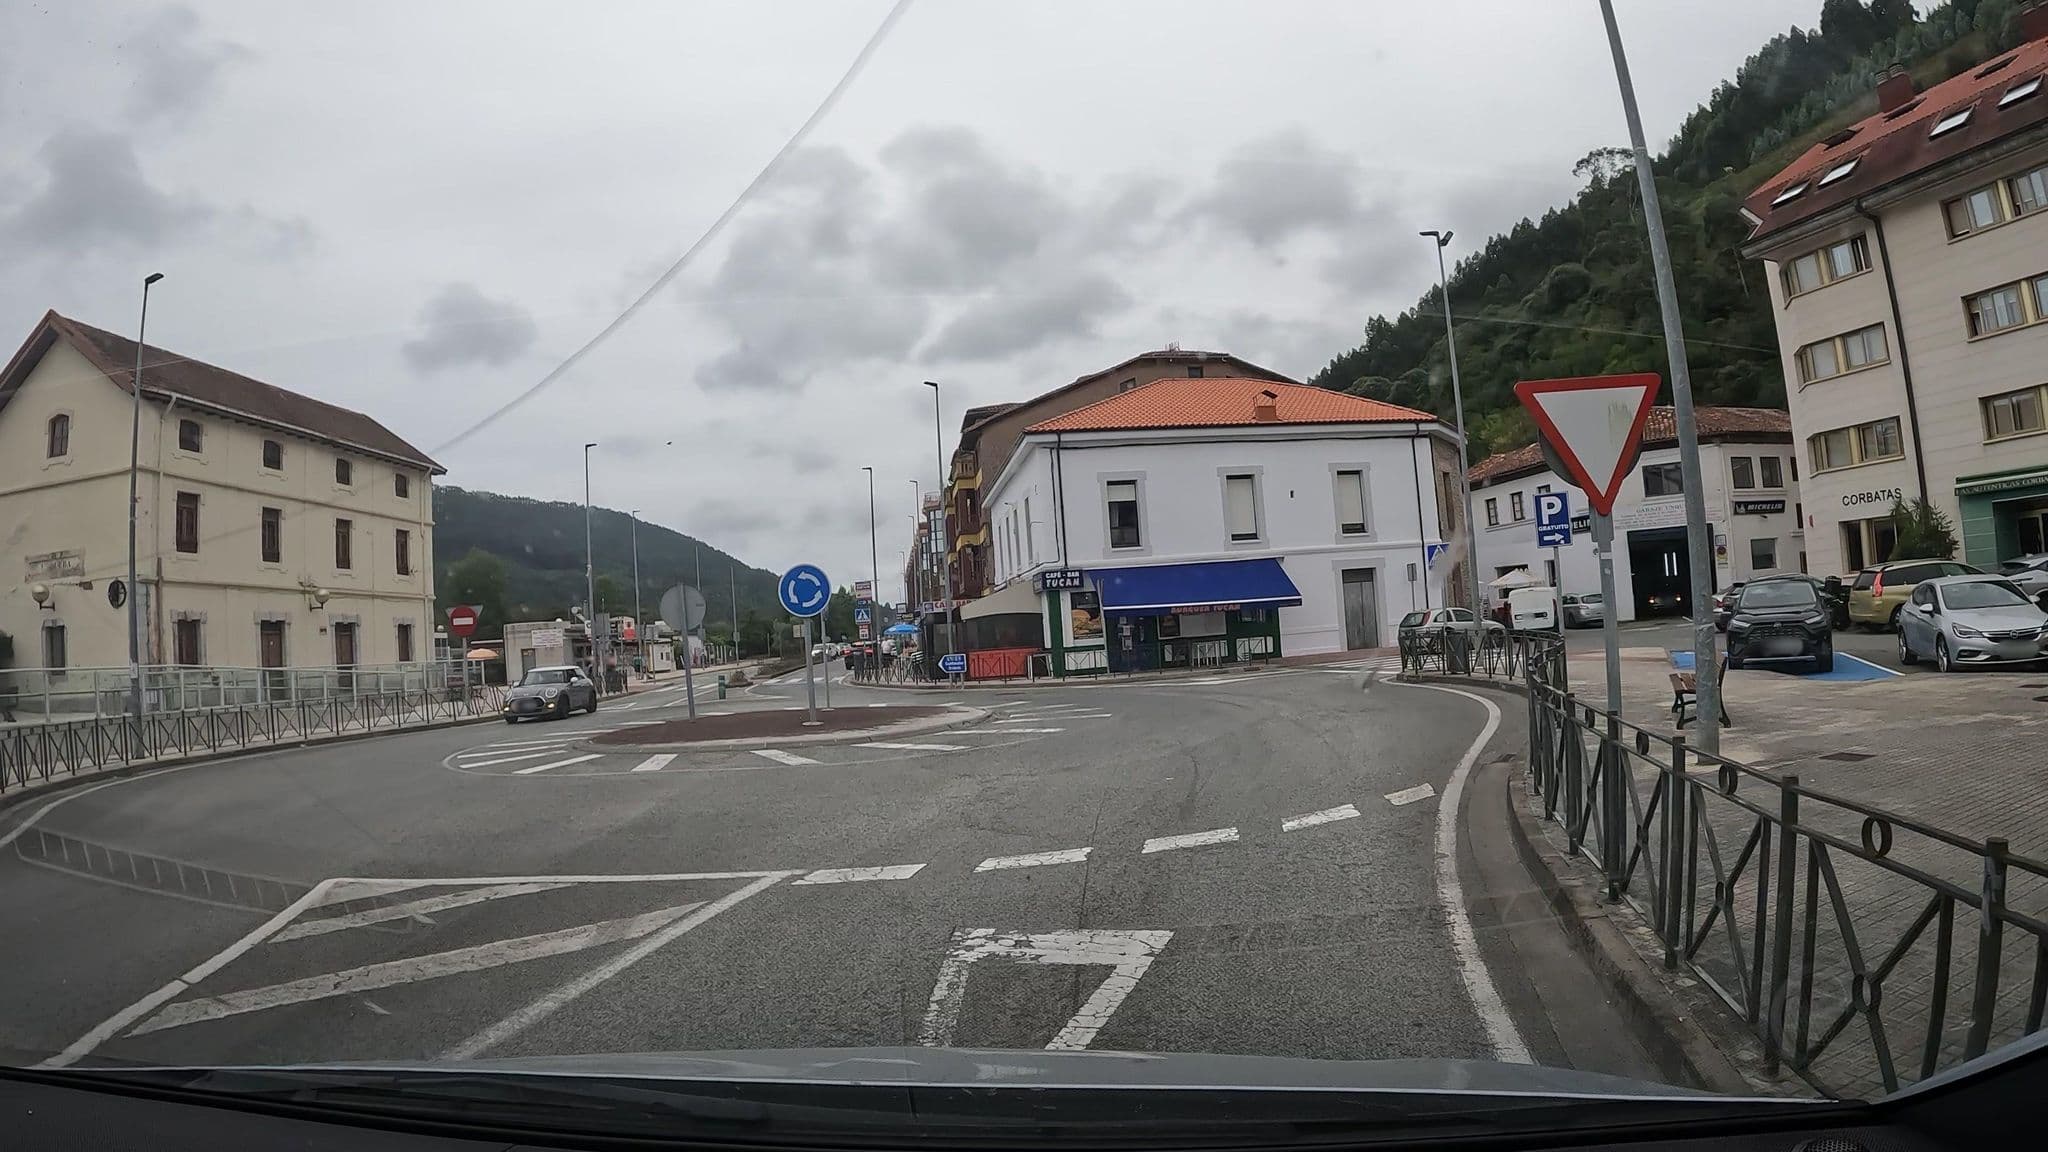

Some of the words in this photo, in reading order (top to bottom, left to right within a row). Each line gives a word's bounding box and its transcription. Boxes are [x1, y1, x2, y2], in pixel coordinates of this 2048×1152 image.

[1842, 488, 1902, 506] CORBATAS
[1540, 496, 1562, 525] P
[1747, 503, 1783, 511] MICHELIN
[1538, 524, 1569, 532] GRATUITO
